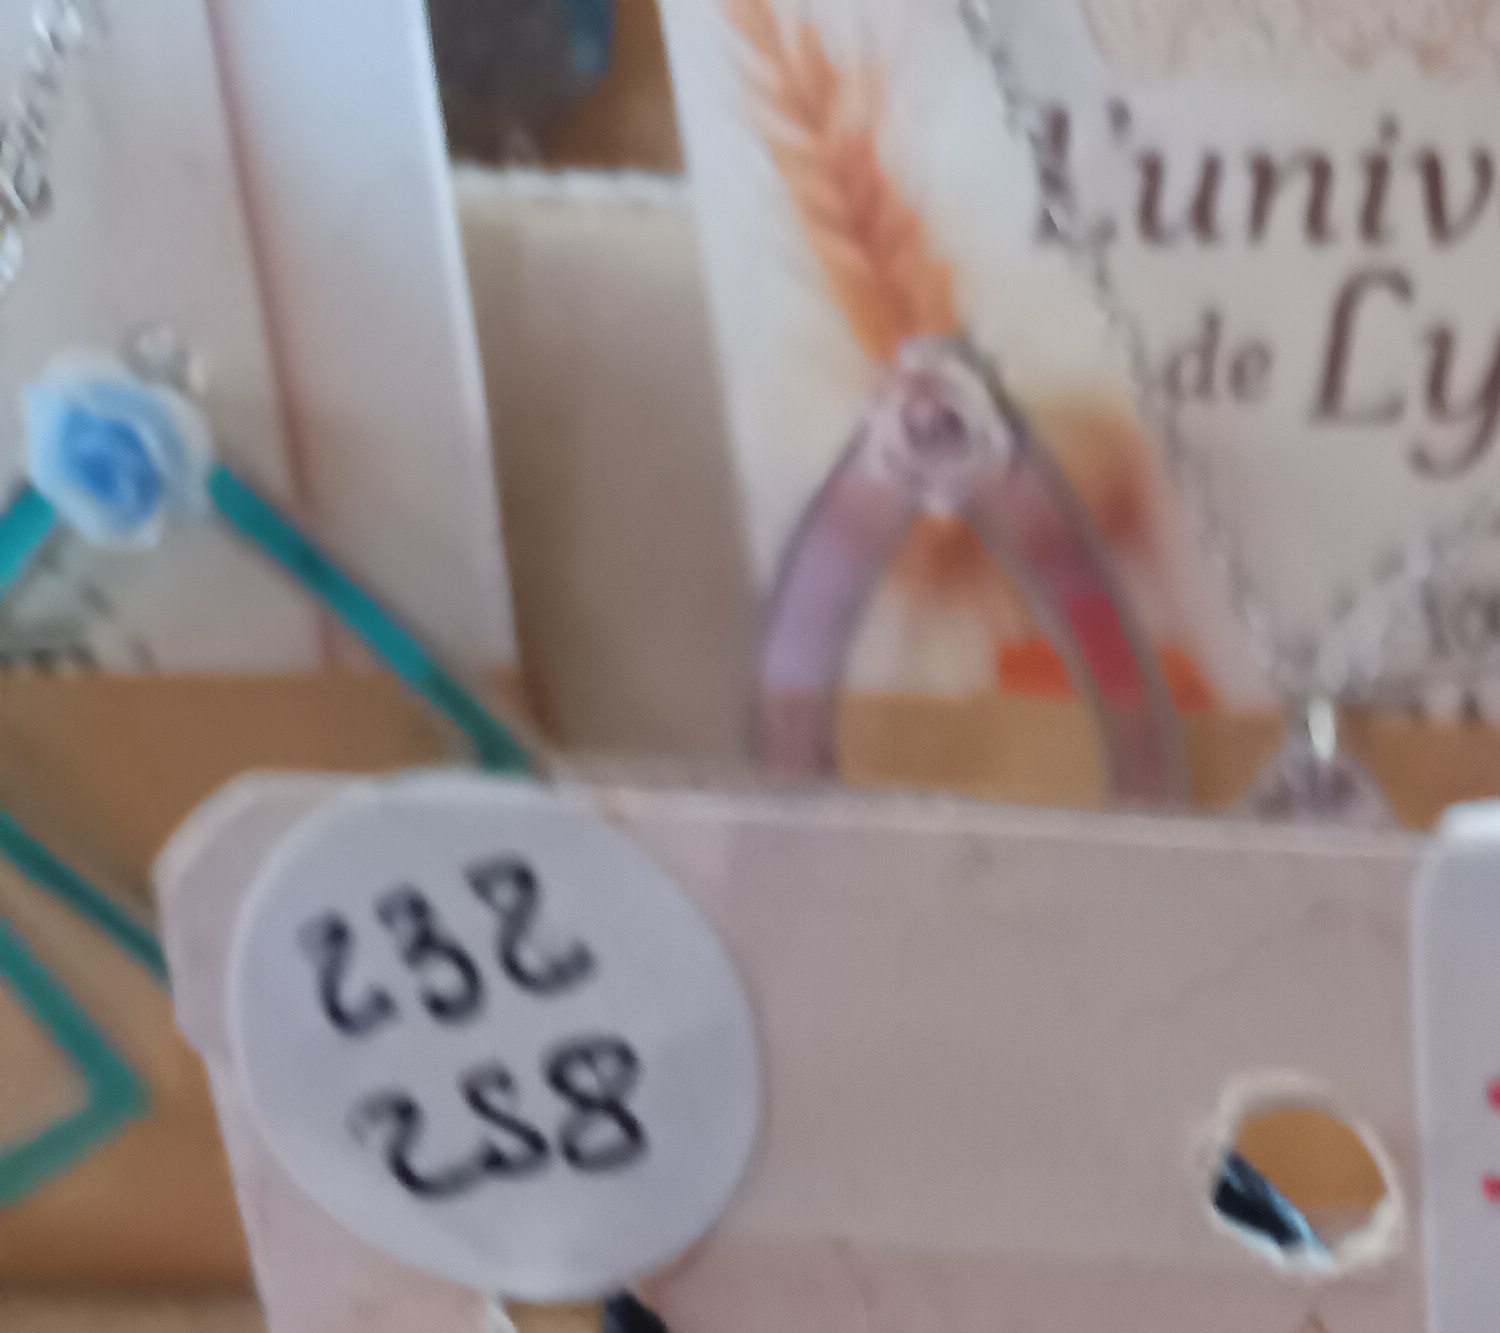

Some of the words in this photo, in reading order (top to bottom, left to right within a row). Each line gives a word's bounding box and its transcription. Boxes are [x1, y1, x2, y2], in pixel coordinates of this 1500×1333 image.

[1160, 310, 1274, 406] de
[297, 850, 602, 1042] 232
[342, 1028, 655, 1202] 258
